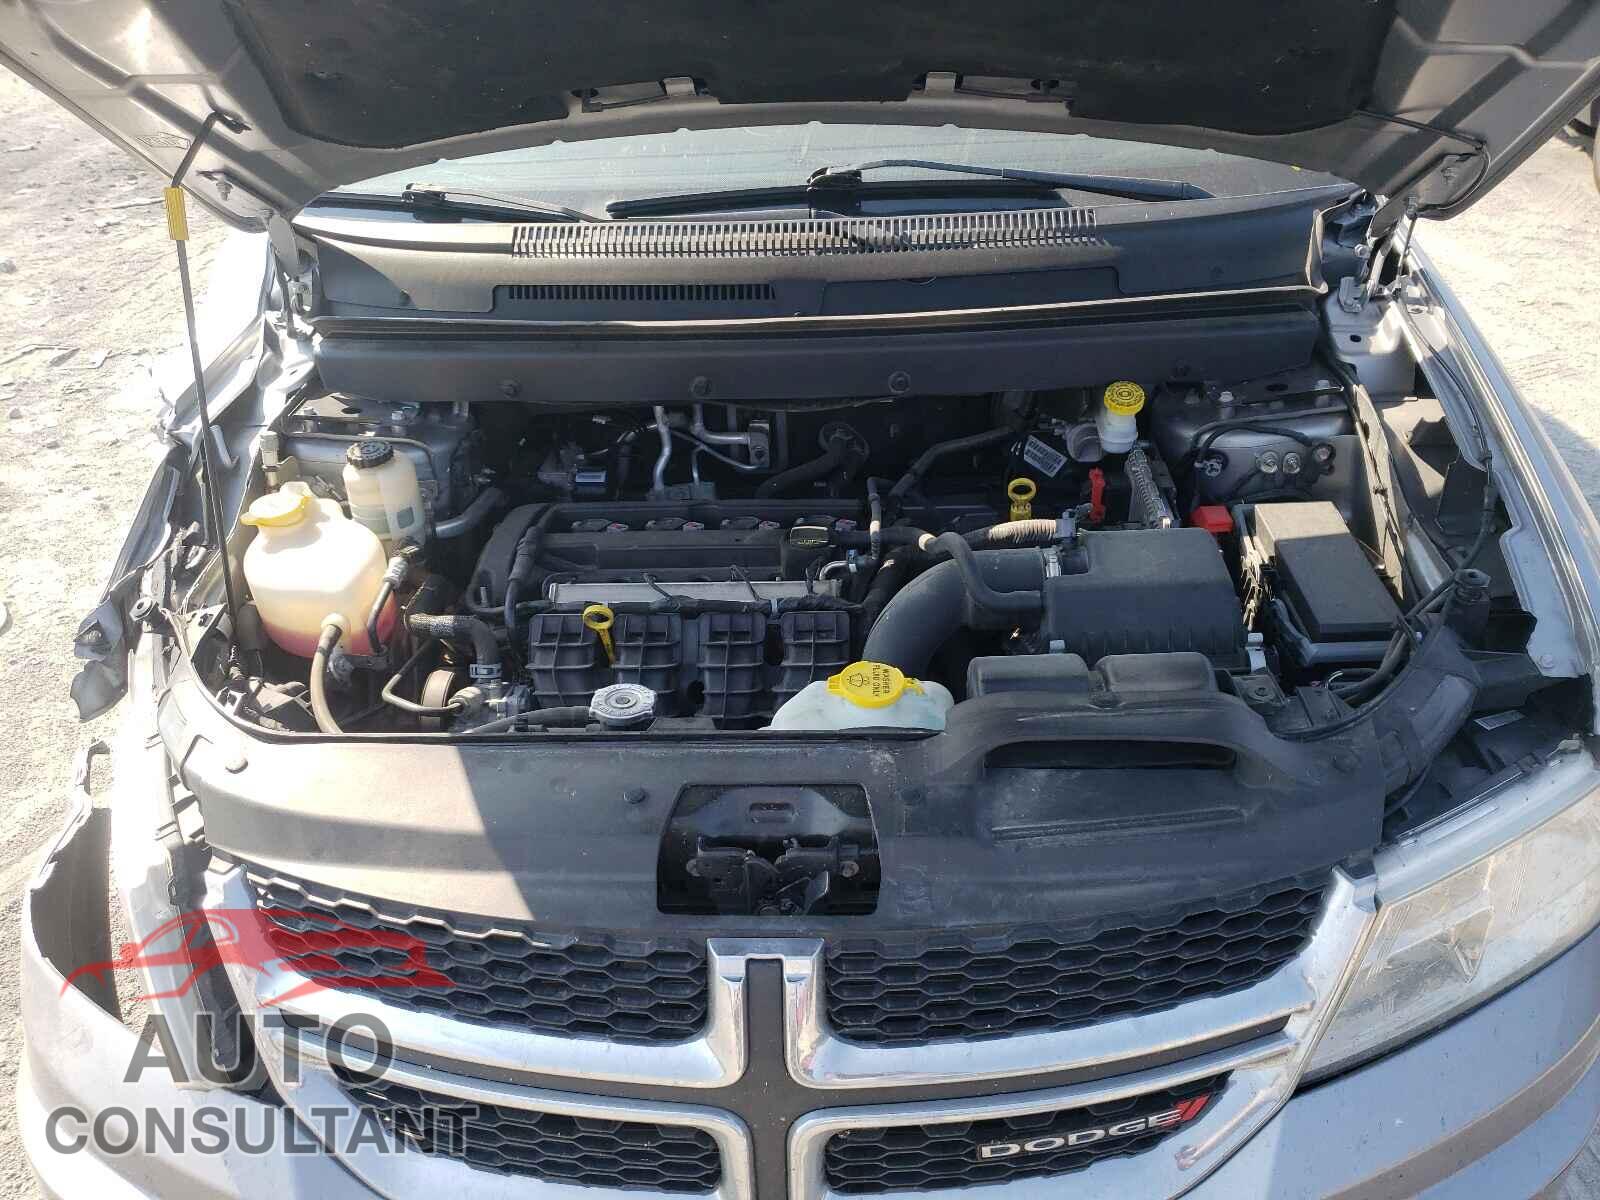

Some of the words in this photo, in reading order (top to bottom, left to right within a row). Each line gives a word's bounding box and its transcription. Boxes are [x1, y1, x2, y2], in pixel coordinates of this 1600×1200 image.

[872, 664, 880, 681] FLUID
[882, 668, 891, 694] WASHER
[872, 682, 880, 697] ONLY
[978, 1109, 1182, 1159] DODGE
